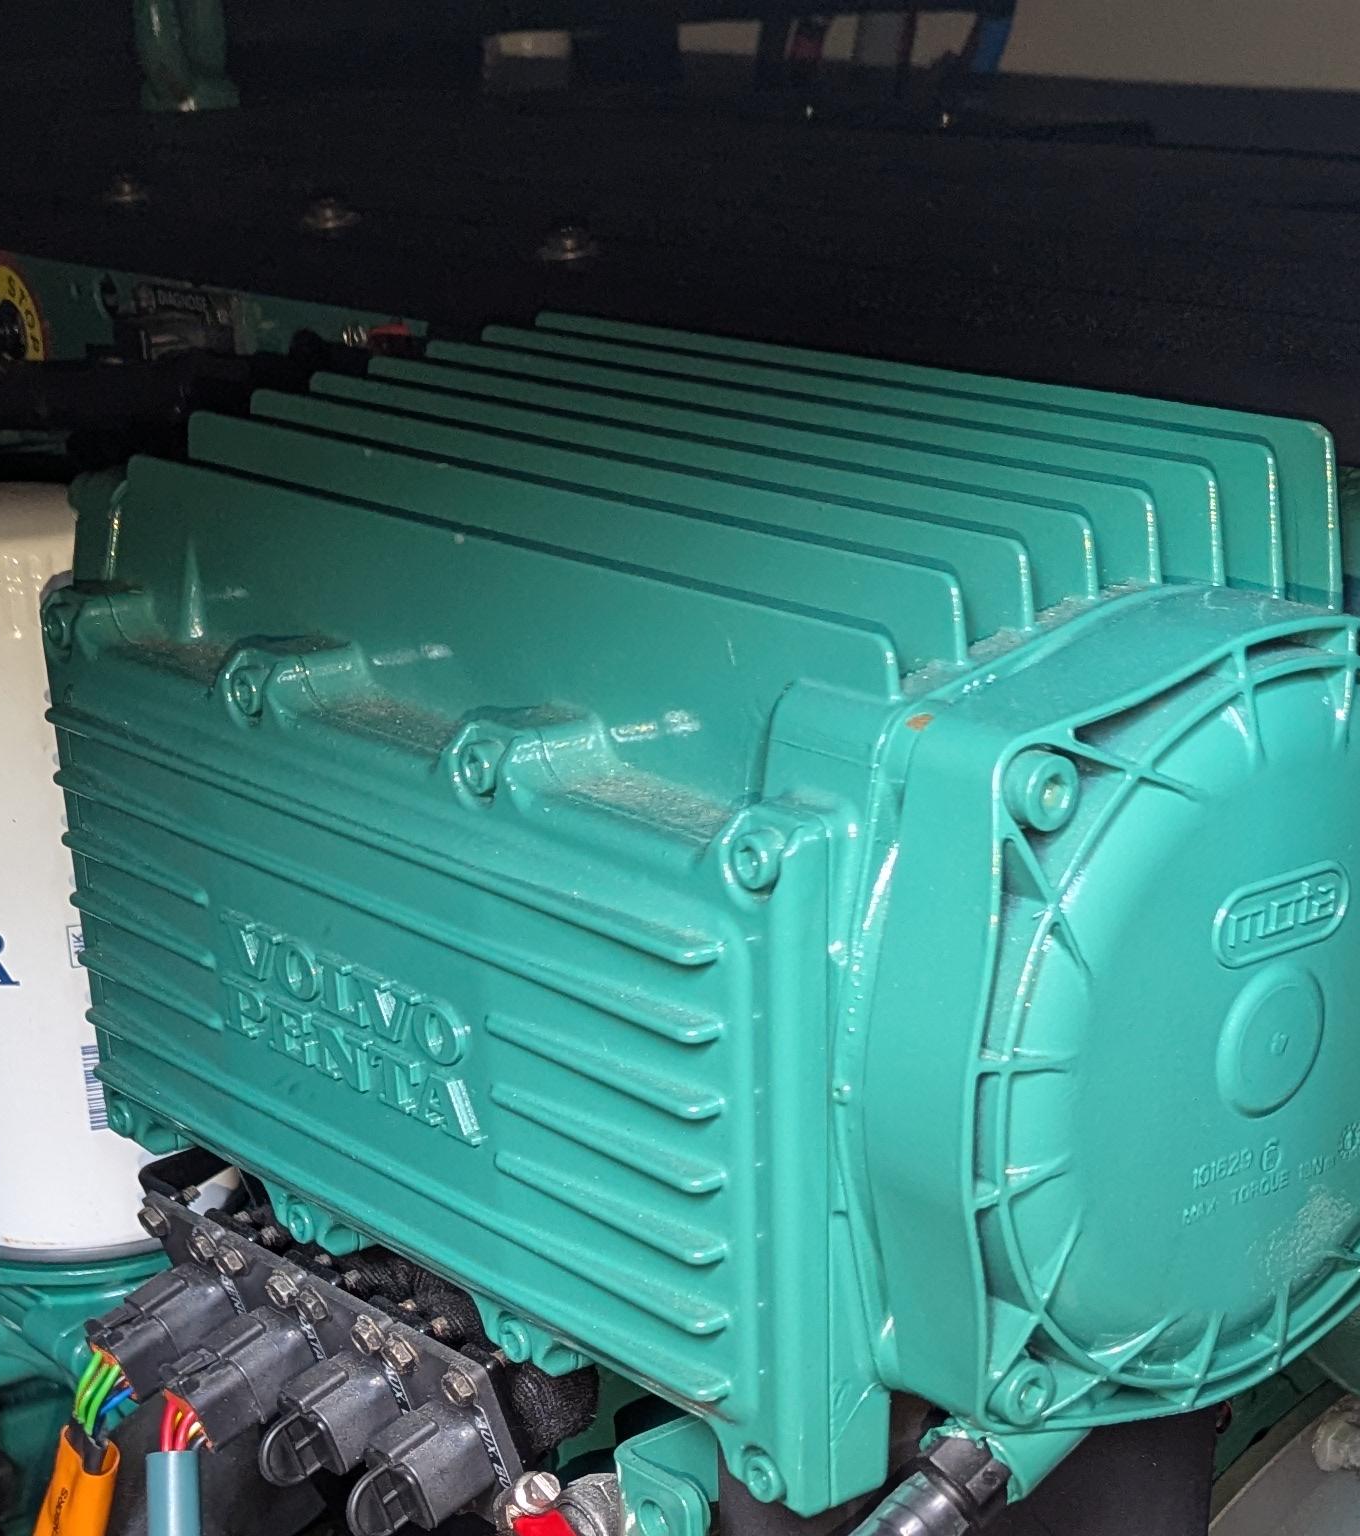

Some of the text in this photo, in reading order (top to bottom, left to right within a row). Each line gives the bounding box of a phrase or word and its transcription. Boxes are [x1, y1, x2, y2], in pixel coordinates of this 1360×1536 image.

[220, 907, 471, 1067] VOLVO
[221, 976, 487, 1147] PENTA
[1230, 1169, 1291, 1206] TORQUE
